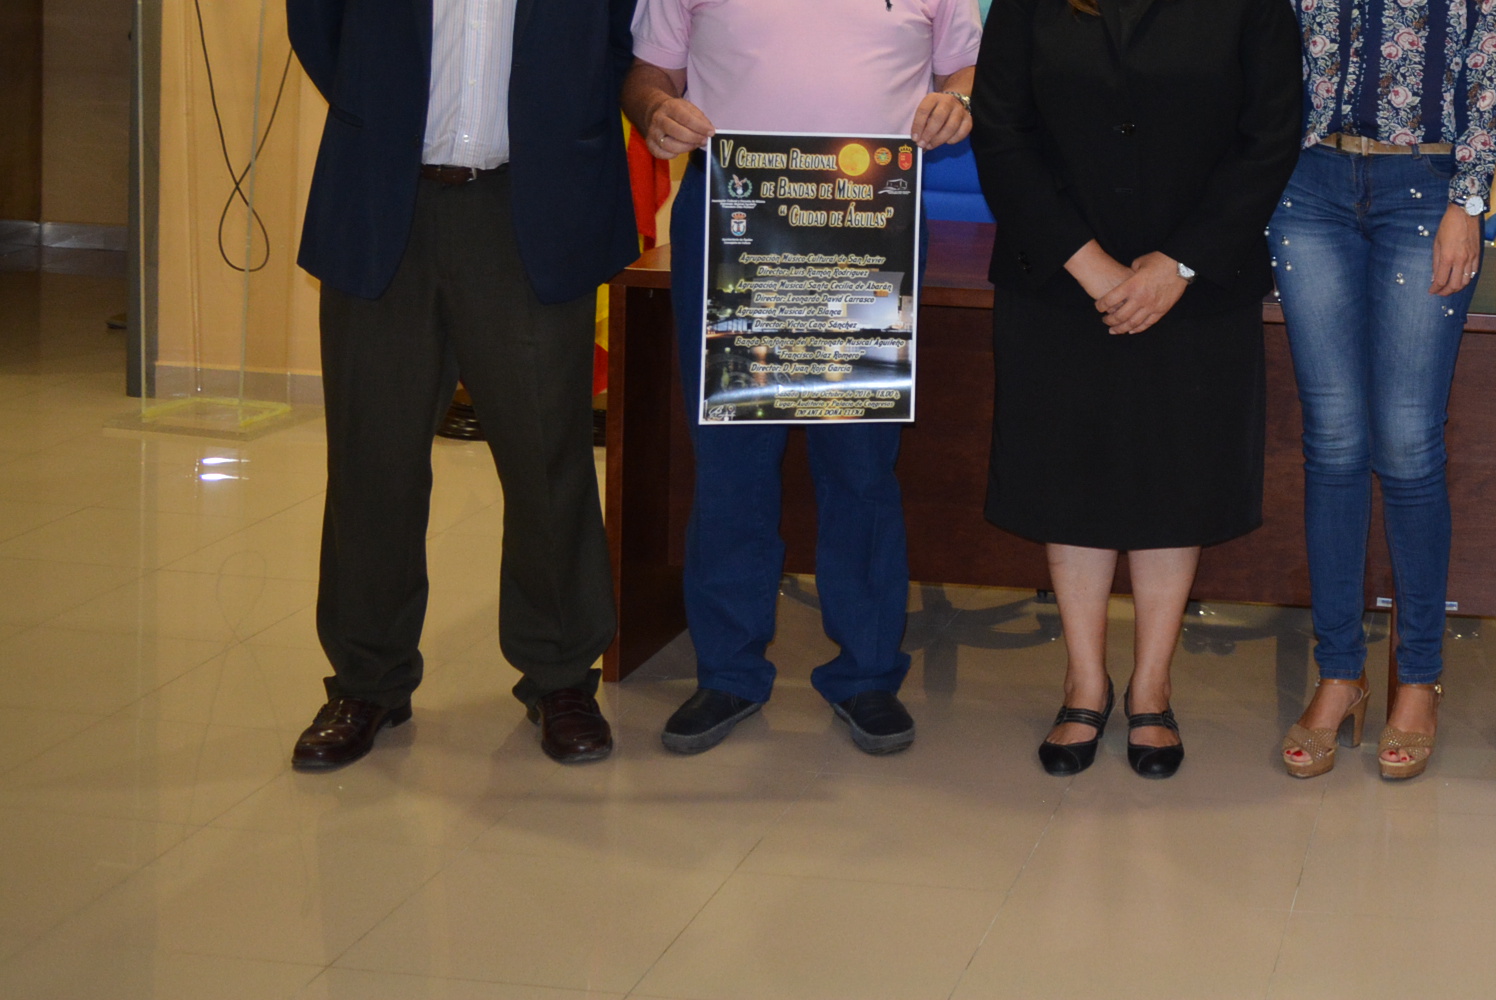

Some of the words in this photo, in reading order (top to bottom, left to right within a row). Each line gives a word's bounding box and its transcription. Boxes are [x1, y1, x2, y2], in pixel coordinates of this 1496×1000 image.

[720, 139, 733, 168] V
[736, 147, 787, 169] CERTAMEN
[789, 148, 837, 170] REGIONAL
[761, 182, 775, 198] DE
[777, 177, 816, 199] BANDAS
[819, 183, 833, 199] DE
[835, 178, 873, 200] MÚSICA
[829, 211, 843, 227] DE
